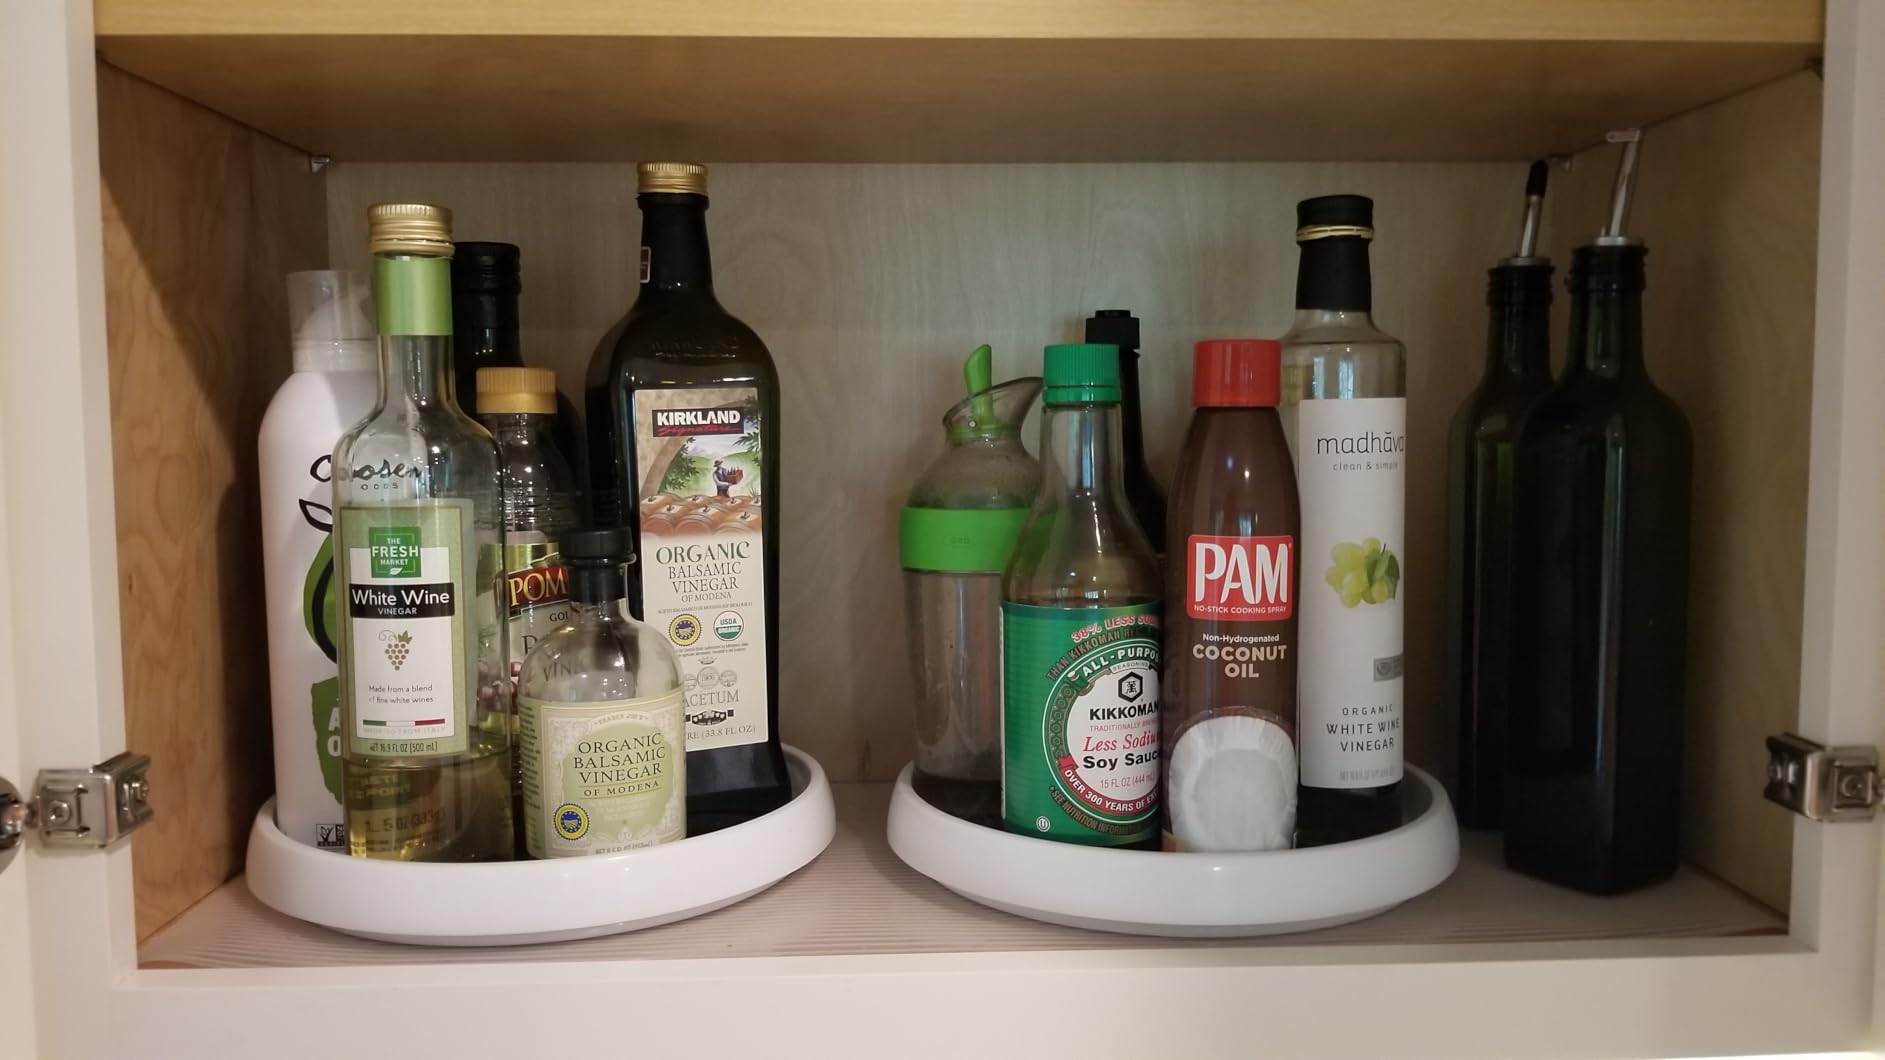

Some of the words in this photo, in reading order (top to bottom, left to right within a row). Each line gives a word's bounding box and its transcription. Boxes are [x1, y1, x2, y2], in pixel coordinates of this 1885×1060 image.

[657, 410, 741, 426] KIRKLAND
[386, 537, 401, 545] THE
[372, 545, 419, 558] FRESH
[656, 540, 751, 565] ORGANIC
[380, 558, 409, 566] MARKET
[668, 561, 742, 580] BALSAMIC
[1195, 542, 1289, 605] PAM
[672, 576, 740, 594] VINEGAR
[351, 588, 397, 607] White
[401, 588, 450, 605] Wine
[681, 594, 692, 603] OF
[694, 591, 732, 602] MODENA
[377, 607, 418, 616] VINEGAR
[1193, 605, 1228, 614] NO-STICK
[1230, 606, 1266, 614] COOKING
[1267, 605, 1287, 613] SPRAY
[720, 617, 738, 626] USDA
[1071, 624, 1102, 643] 38%
[1104, 615, 1136, 630] LESS
[1202, 632, 1280, 644] Non-Hydrogenated
[1047, 657, 1070, 681] THAN
[1069, 629, 1121, 659] KIKKOMAN
[1192, 643, 1288, 662] COCONUT
[1224, 662, 1260, 679] OIL
[368, 684, 386, 693] Made
[387, 684, 404, 693] from
[411, 683, 433, 693] blend
[376, 694, 388, 704] fine
[389, 694, 411, 704] white
[411, 694, 434, 704] wines
[1342, 703, 1393, 717] ORGANIC
[725, 726, 737, 736] FL
[1326, 723, 1374, 735] WHITE
[1377, 717, 1400, 733] WINE
[392, 743, 399, 752] FL
[399, 743, 408, 752] OZ
[578, 732, 662, 755] ORGANIC
[1083, 735, 1117, 753] Less
[1340, 737, 1395, 752] VINEGAR
[574, 746, 667, 769] BALSAMIC
[1083, 755, 1119, 772] Soy
[579, 762, 663, 784] VINEGAR
[583, 789, 601, 797] OF
[606, 780, 660, 795] MODENA
[1065, 769, 1087, 794] OVER
[1085, 790, 1103, 807] 300
[1105, 800, 1134, 813] YEARS
[1135, 799, 1147, 810] OF
[1100, 779, 1110, 790] 15
[1111, 778, 1121, 788] FL
[1121, 777, 1131, 788] OZ
[1062, 802, 1098, 829] NUTRITION
